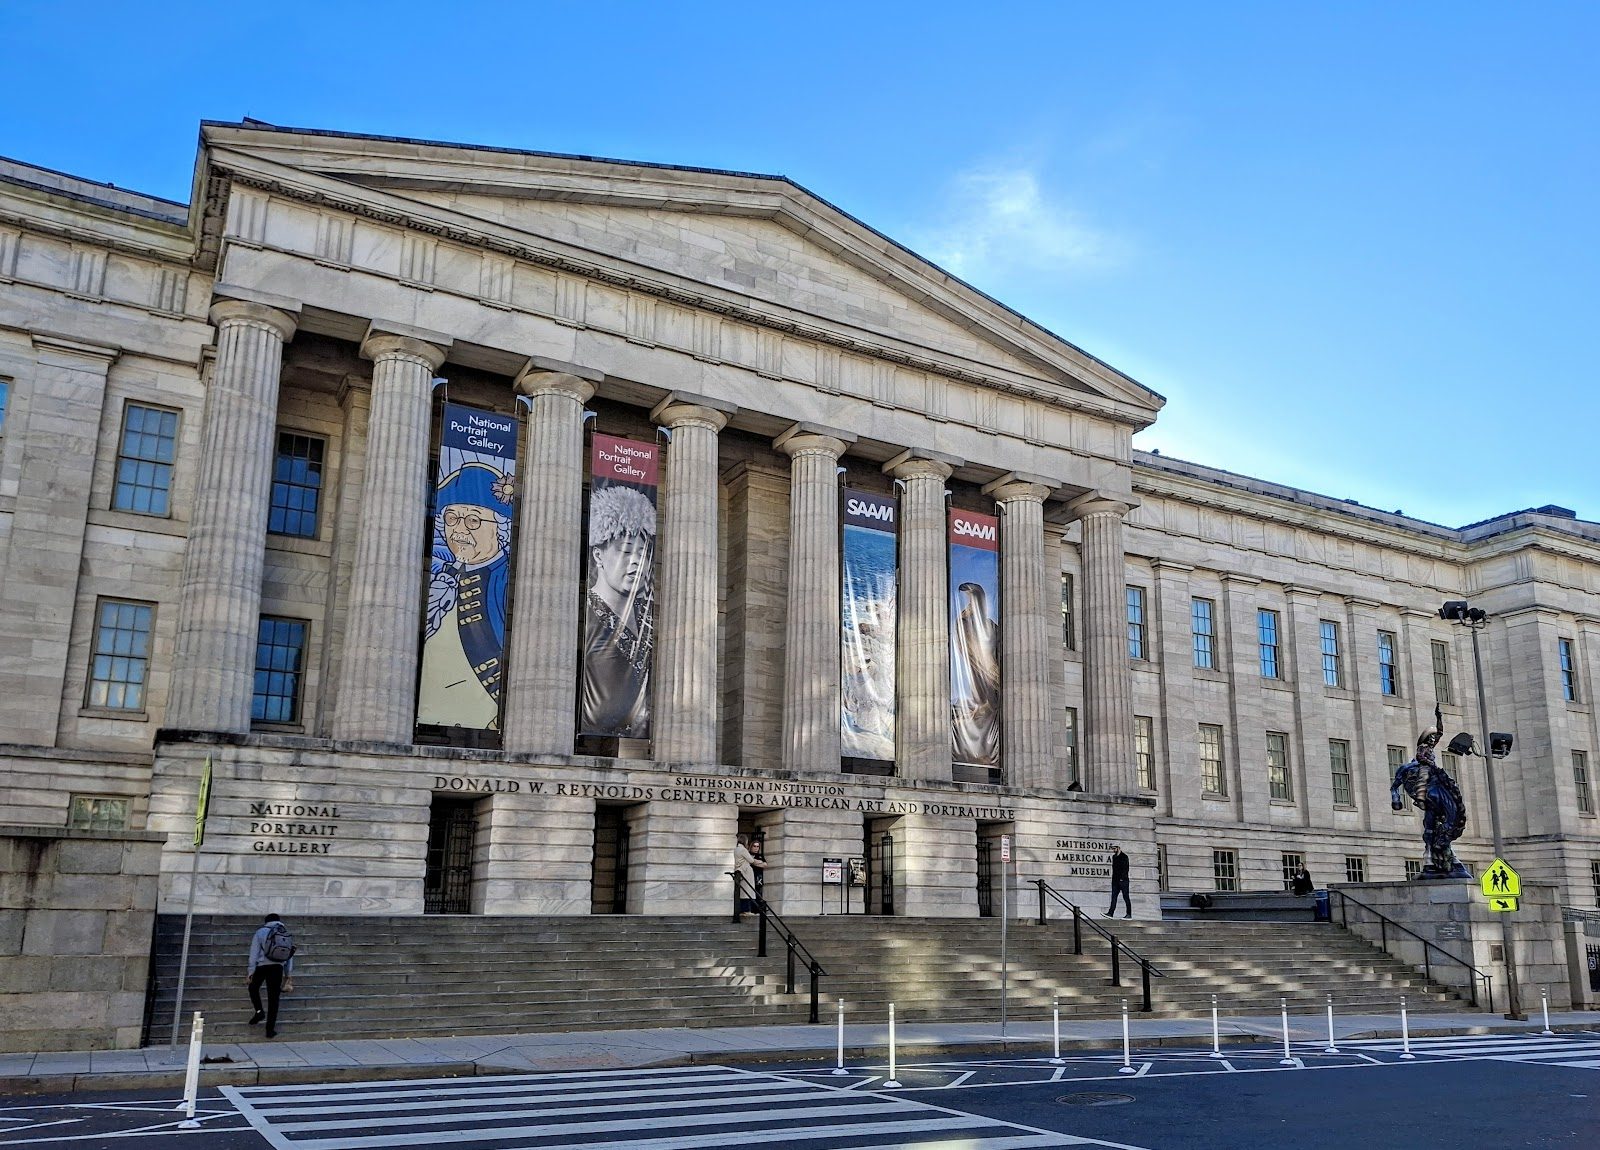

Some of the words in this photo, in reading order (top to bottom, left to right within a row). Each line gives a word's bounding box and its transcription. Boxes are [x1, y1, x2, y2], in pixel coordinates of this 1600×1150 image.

[450, 420, 487, 437] Portrait
[468, 415, 511, 433] National
[467, 435, 504, 453] Gallery
[614, 444, 652, 460] National
[599, 450, 631, 465] Portrait
[613, 463, 646, 479] Gallery
[846, 498, 894, 523] SAAM
[953, 519, 995, 541] SAAM
[675, 777, 764, 791] SMITHSONIAN
[769, 782, 845, 795] INSTITUTION
[434, 776, 520, 793] DONALD
[528, 781, 547, 795] W.
[556, 783, 654, 800] REYNOLDS
[660, 788, 726, 803] CENTER
[734, 792, 764, 805] FOR
[771, 795, 850, 810] AMERICAN
[857, 801, 883, 812] ART
[888, 802, 917, 814] AND
[923, 804, 1015, 820] PORTRAITURE
[250, 803, 341, 818] NATIONAL
[250, 822, 338, 836] PORTRAIT
[253, 841, 331, 853] GALLERY
[1056, 839, 1113, 850] SMITHSONIA
[1055, 852, 1103, 863] AMERICAN
[1071, 867, 1110, 876] MUSEUM
